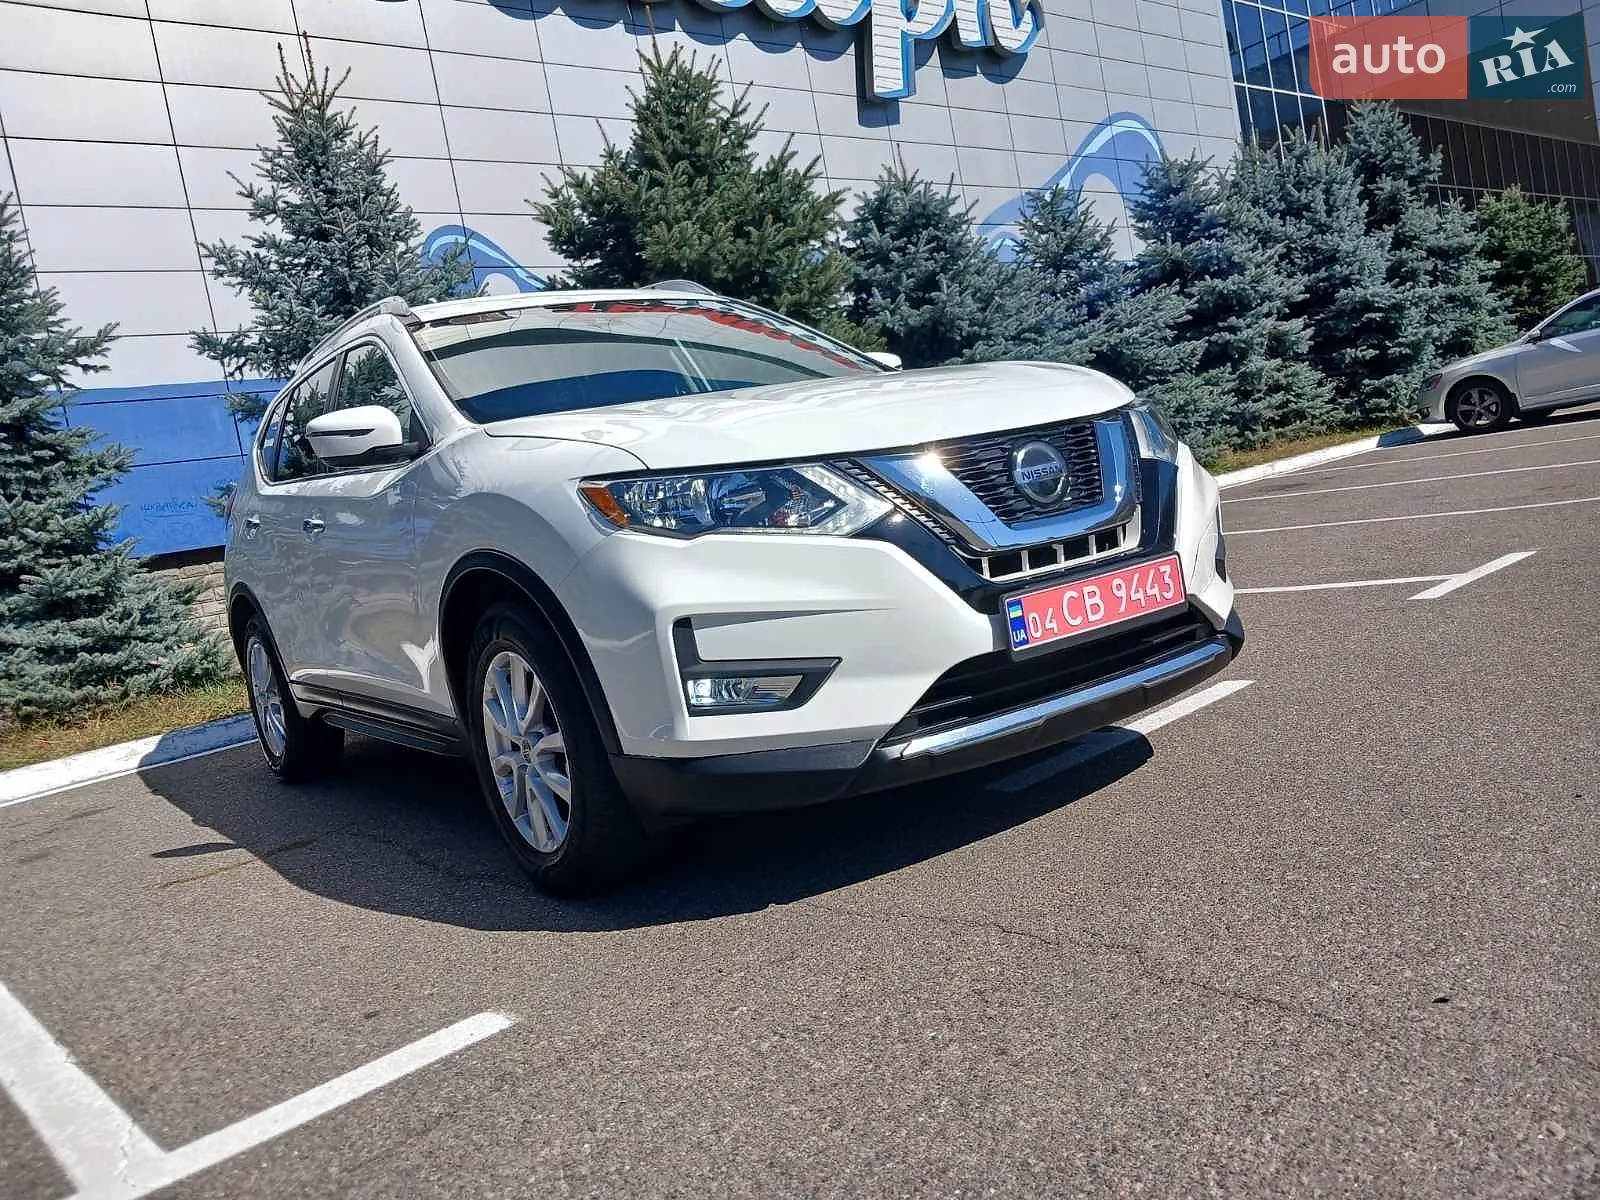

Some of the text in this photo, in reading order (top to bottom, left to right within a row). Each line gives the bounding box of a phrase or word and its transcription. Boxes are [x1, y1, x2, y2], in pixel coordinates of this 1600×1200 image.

[1021, 463, 1062, 481] NISSAN
[1028, 564, 1174, 639] 04 CB 9443
[1013, 629, 1028, 642] UA
